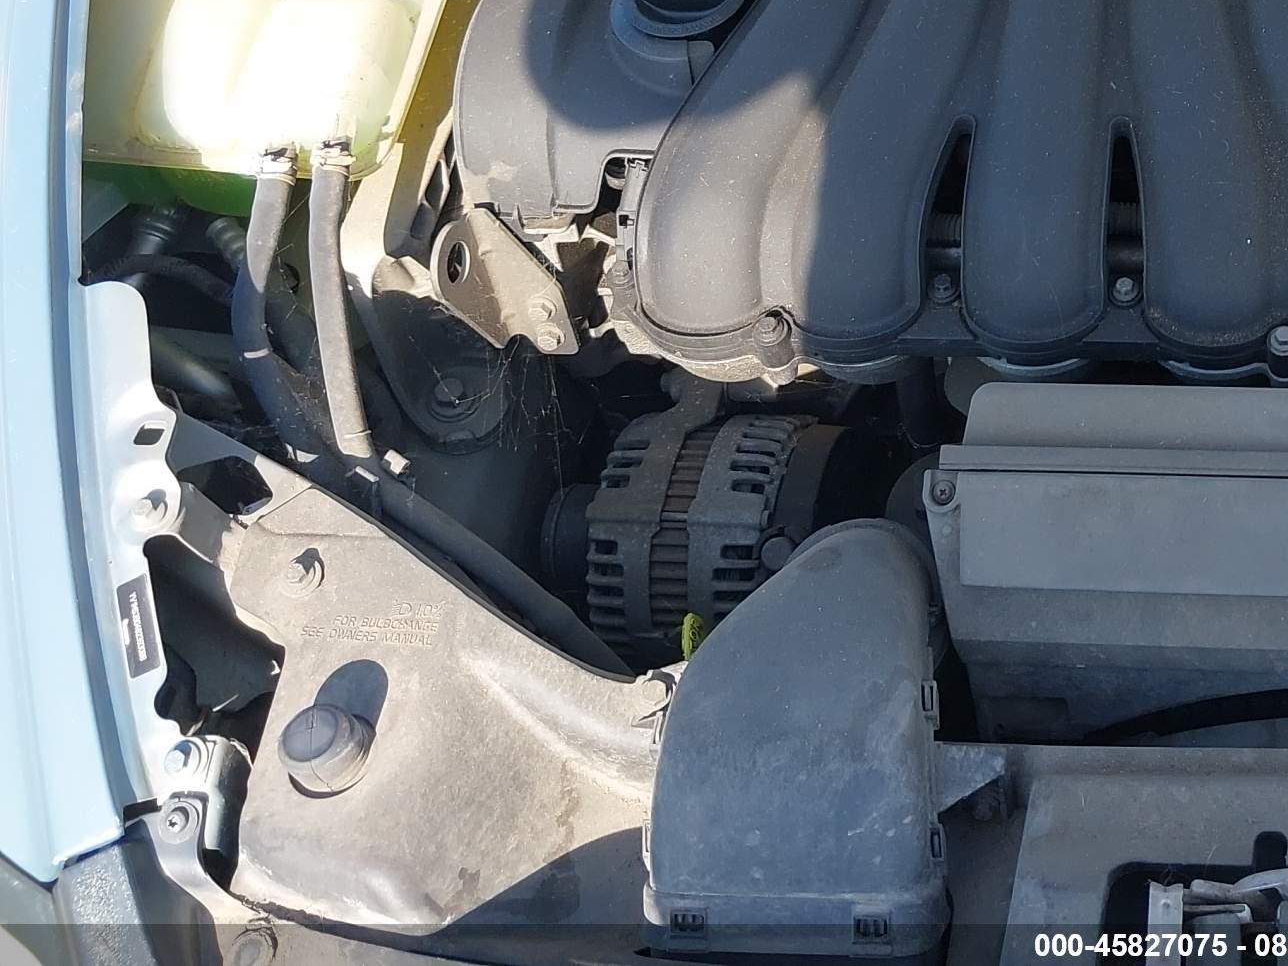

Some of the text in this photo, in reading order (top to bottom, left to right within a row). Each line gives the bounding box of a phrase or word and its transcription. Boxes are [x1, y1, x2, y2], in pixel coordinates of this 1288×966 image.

[333, 615, 357, 627] FOR
[301, 625, 434, 646] SEE OWNERS MANUAL
